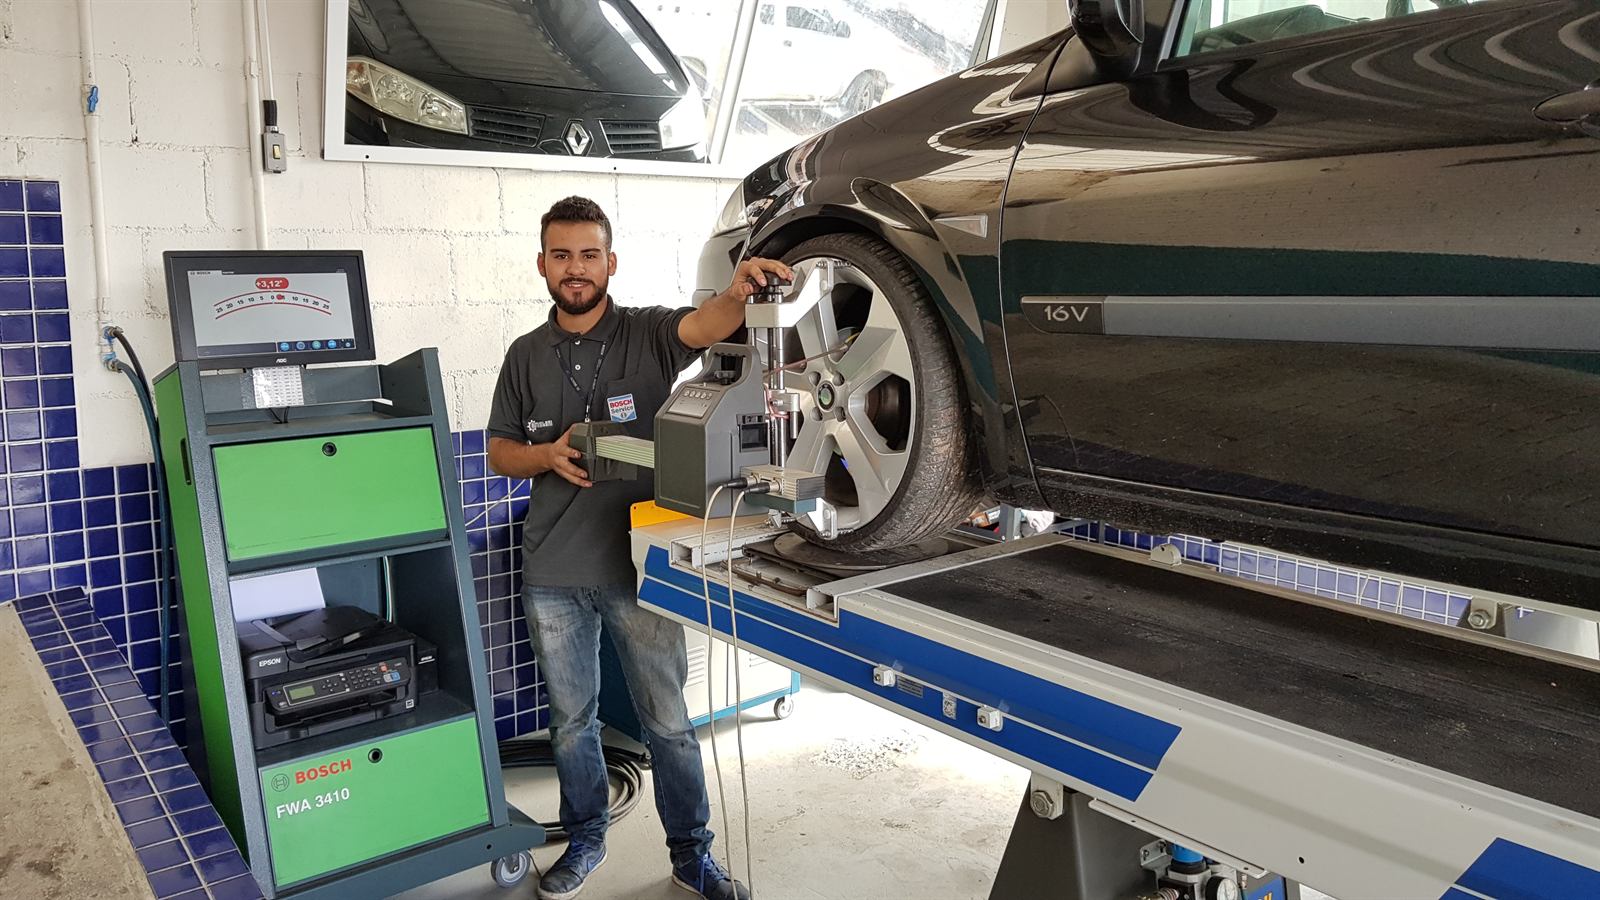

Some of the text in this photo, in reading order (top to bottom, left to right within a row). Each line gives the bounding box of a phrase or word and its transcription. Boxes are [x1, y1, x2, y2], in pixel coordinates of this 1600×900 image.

[610, 399, 632, 408] BOSCH
[611, 405, 633, 414] Service
[259, 657, 281, 667] EPSON
[295, 758, 352, 785] BOSCH
[276, 787, 350, 819] FWA 3410
